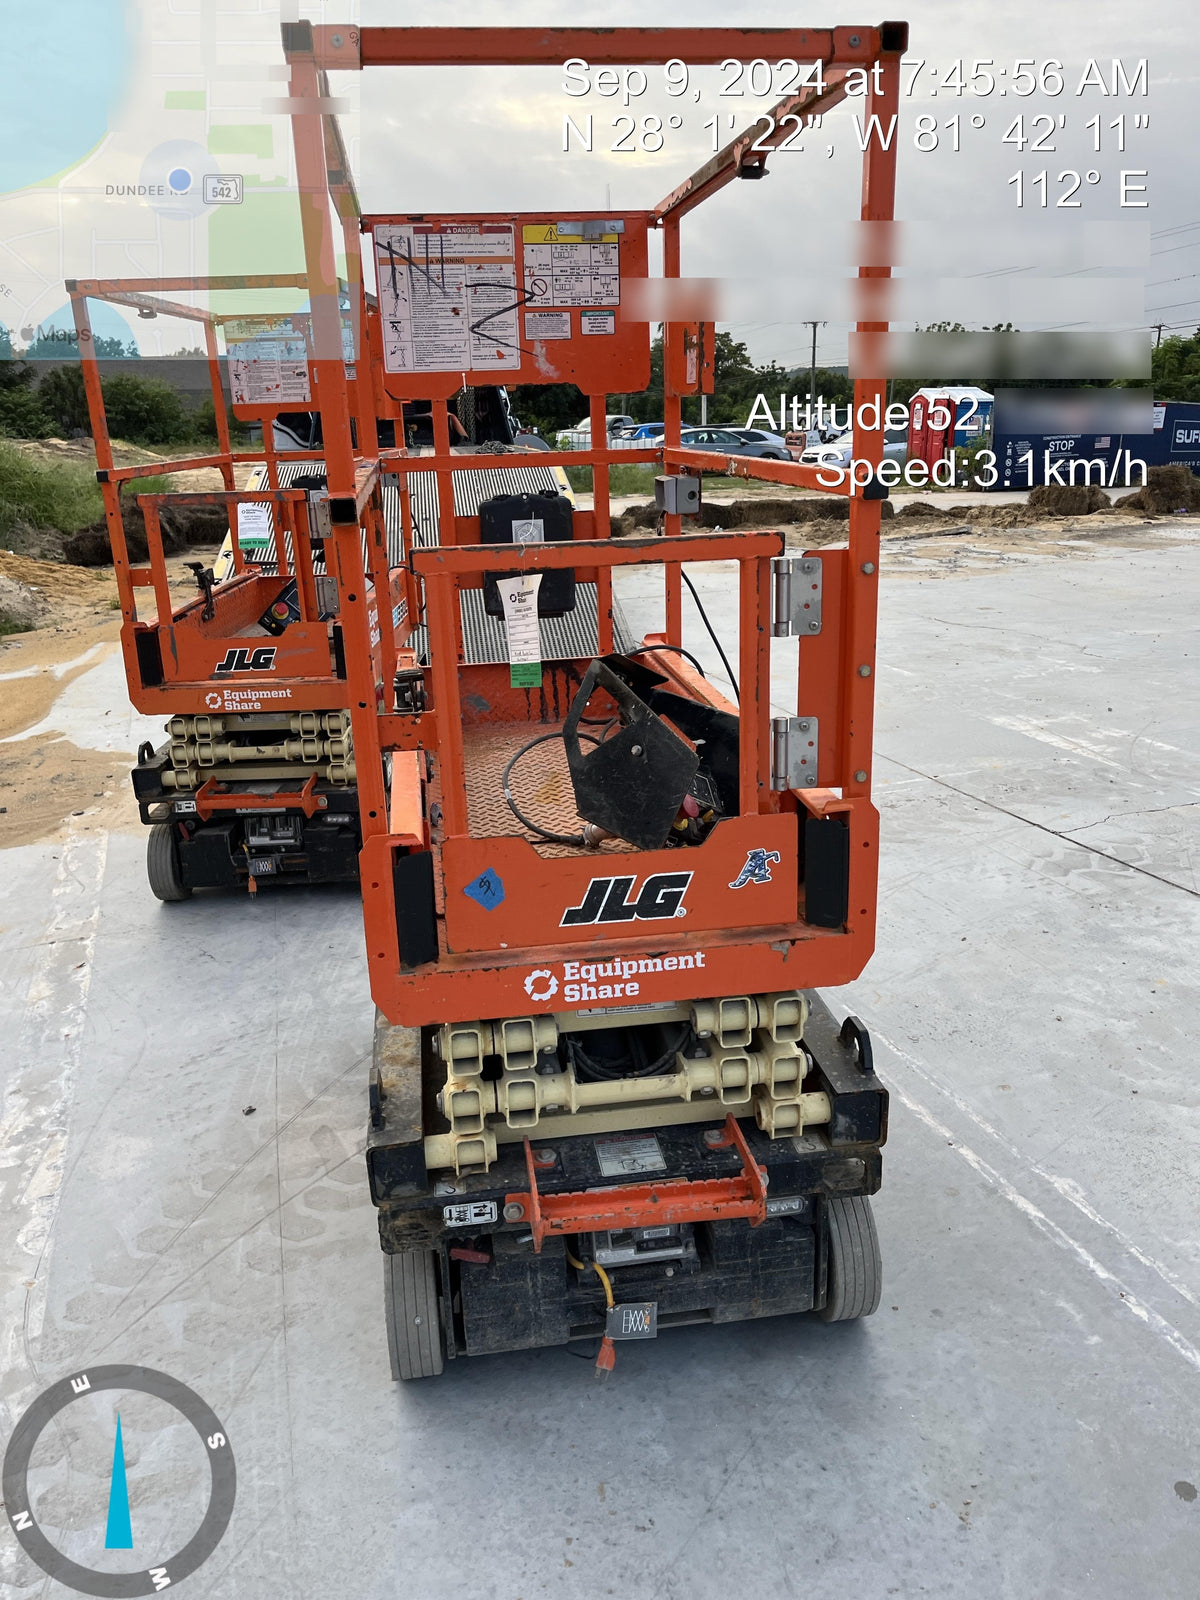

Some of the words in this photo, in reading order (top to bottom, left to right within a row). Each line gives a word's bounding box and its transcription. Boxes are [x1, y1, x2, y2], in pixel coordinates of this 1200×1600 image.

[452, 227, 481, 235] DANGER
[434, 257, 465, 265] WARNING
[1174, 429, 1200, 444] SUF
[1048, 440, 1075, 452] STOP
[214, 646, 278, 673] JLG
[222, 688, 292, 702] Equipment
[223, 700, 262, 711] Share
[558, 870, 695, 928] JLG
[563, 951, 706, 983] Equipment
[563, 982, 640, 1003] Share
